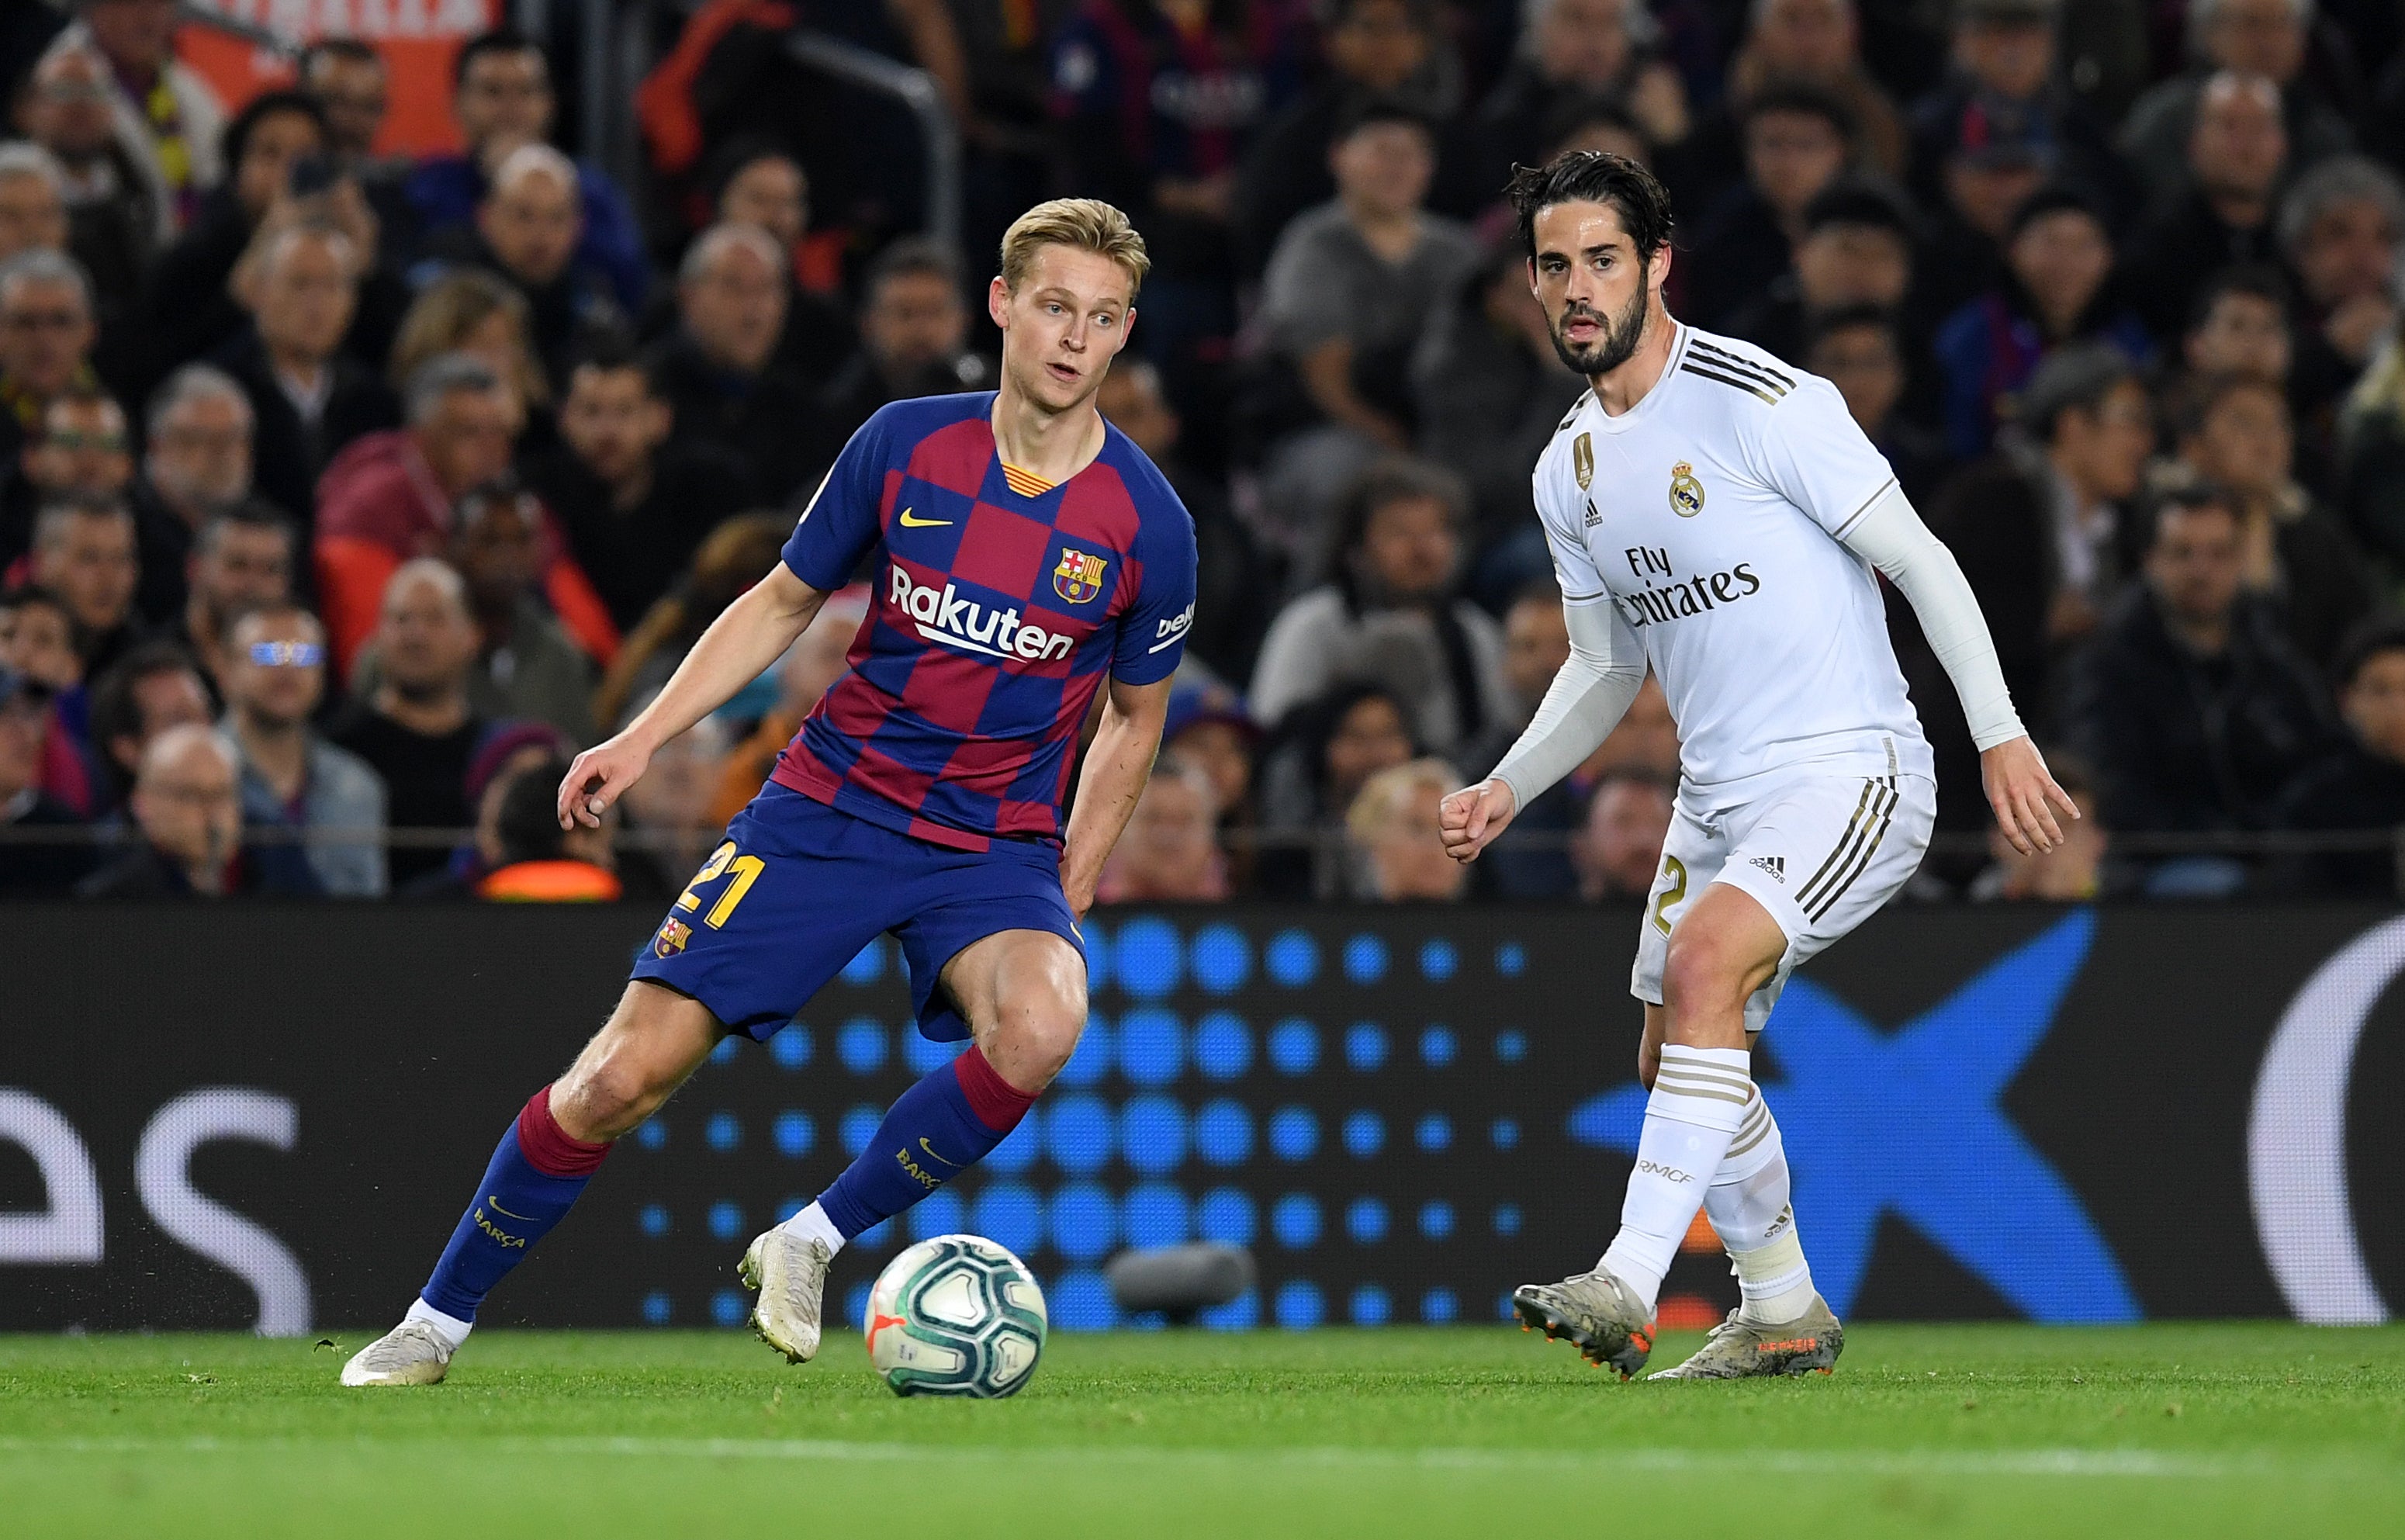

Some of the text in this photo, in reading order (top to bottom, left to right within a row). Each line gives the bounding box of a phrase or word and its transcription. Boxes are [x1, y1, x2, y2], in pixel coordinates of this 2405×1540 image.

[1625, 546, 1672, 577] Fly
[890, 564, 1074, 661] Rakuten
[675, 841, 766, 930] 21
[1749, 857, 1786, 884] adidas
[1645, 853, 1687, 940] 2
[896, 1147, 942, 1189] BARÇ
[1636, 1160, 1696, 1184] RMCF
[474, 1207, 525, 1248] BARÇA
